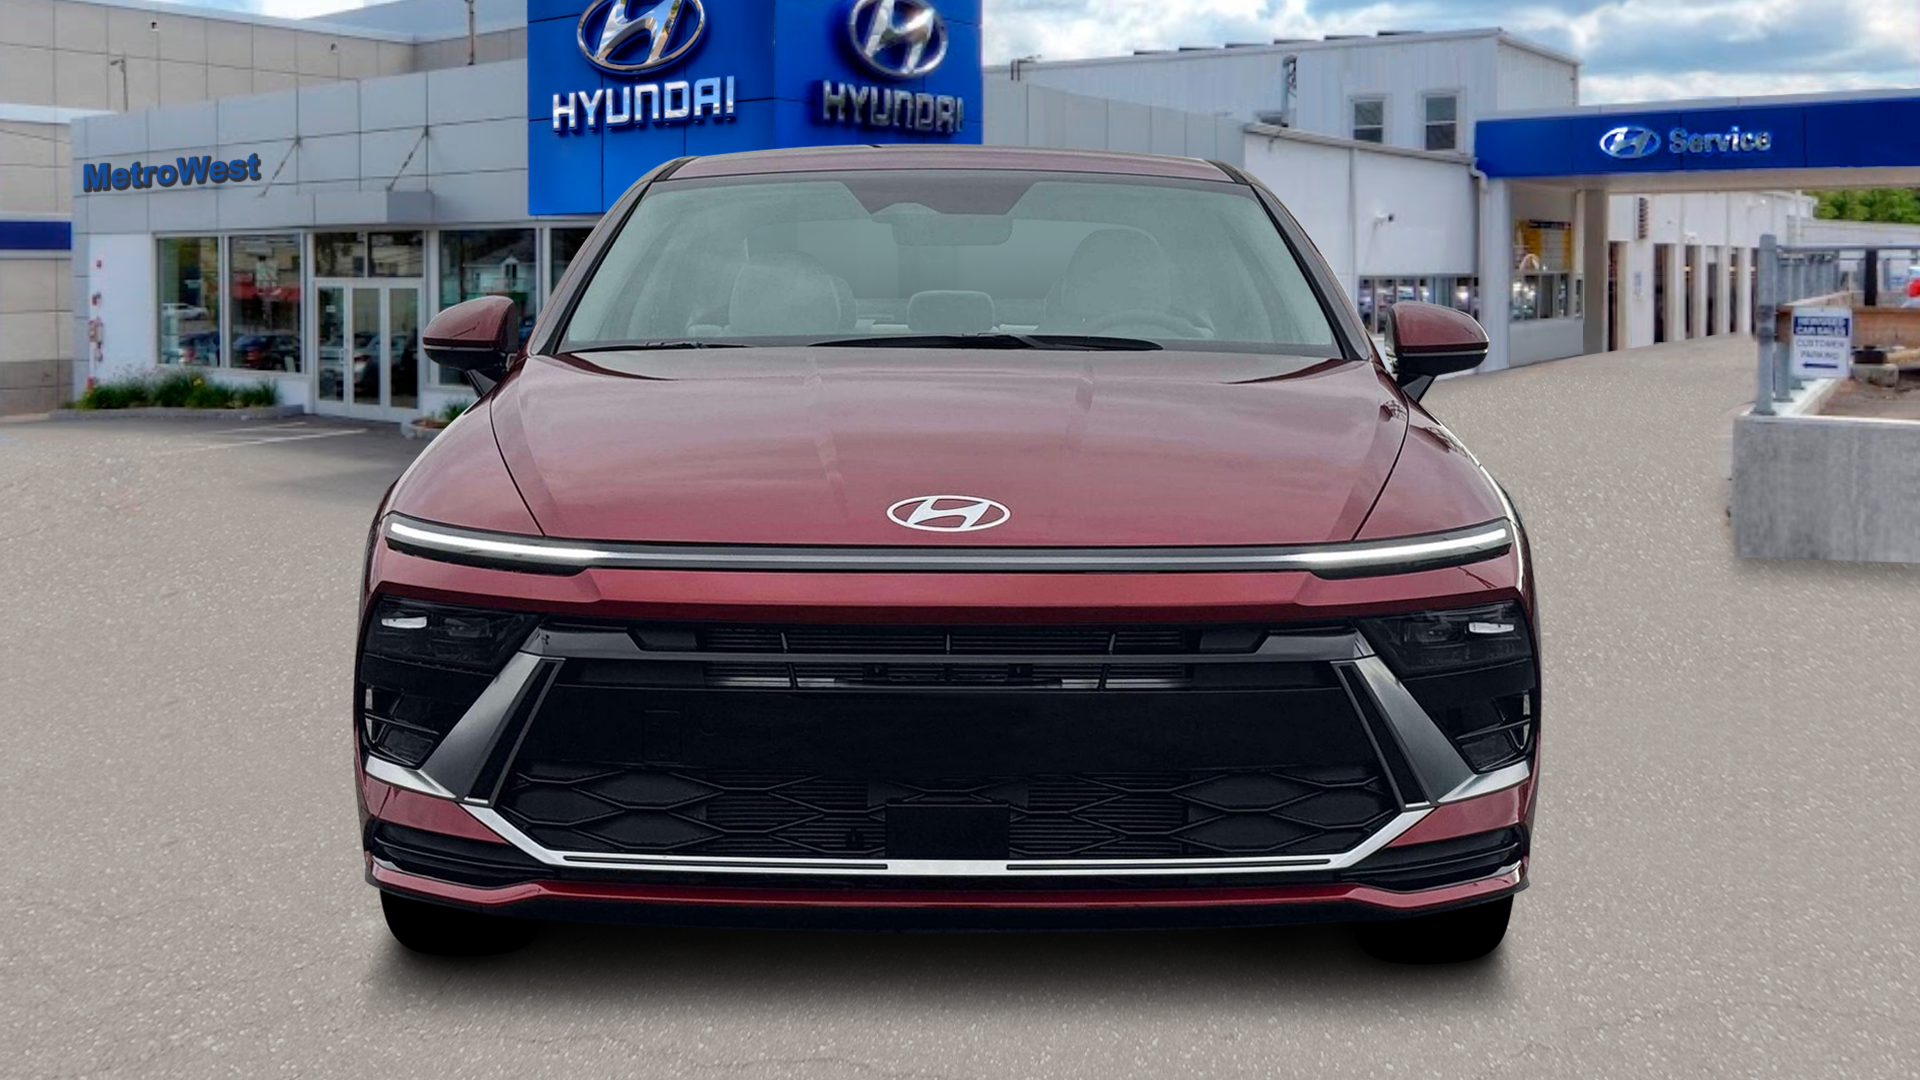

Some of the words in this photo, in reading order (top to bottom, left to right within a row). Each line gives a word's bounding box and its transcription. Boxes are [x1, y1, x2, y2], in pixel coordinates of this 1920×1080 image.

[552, 75, 735, 132] HYUNDAI
[821, 79, 965, 134] HYUNDAI
[1668, 125, 1771, 154] Service
[83, 152, 262, 193] MetroWest
